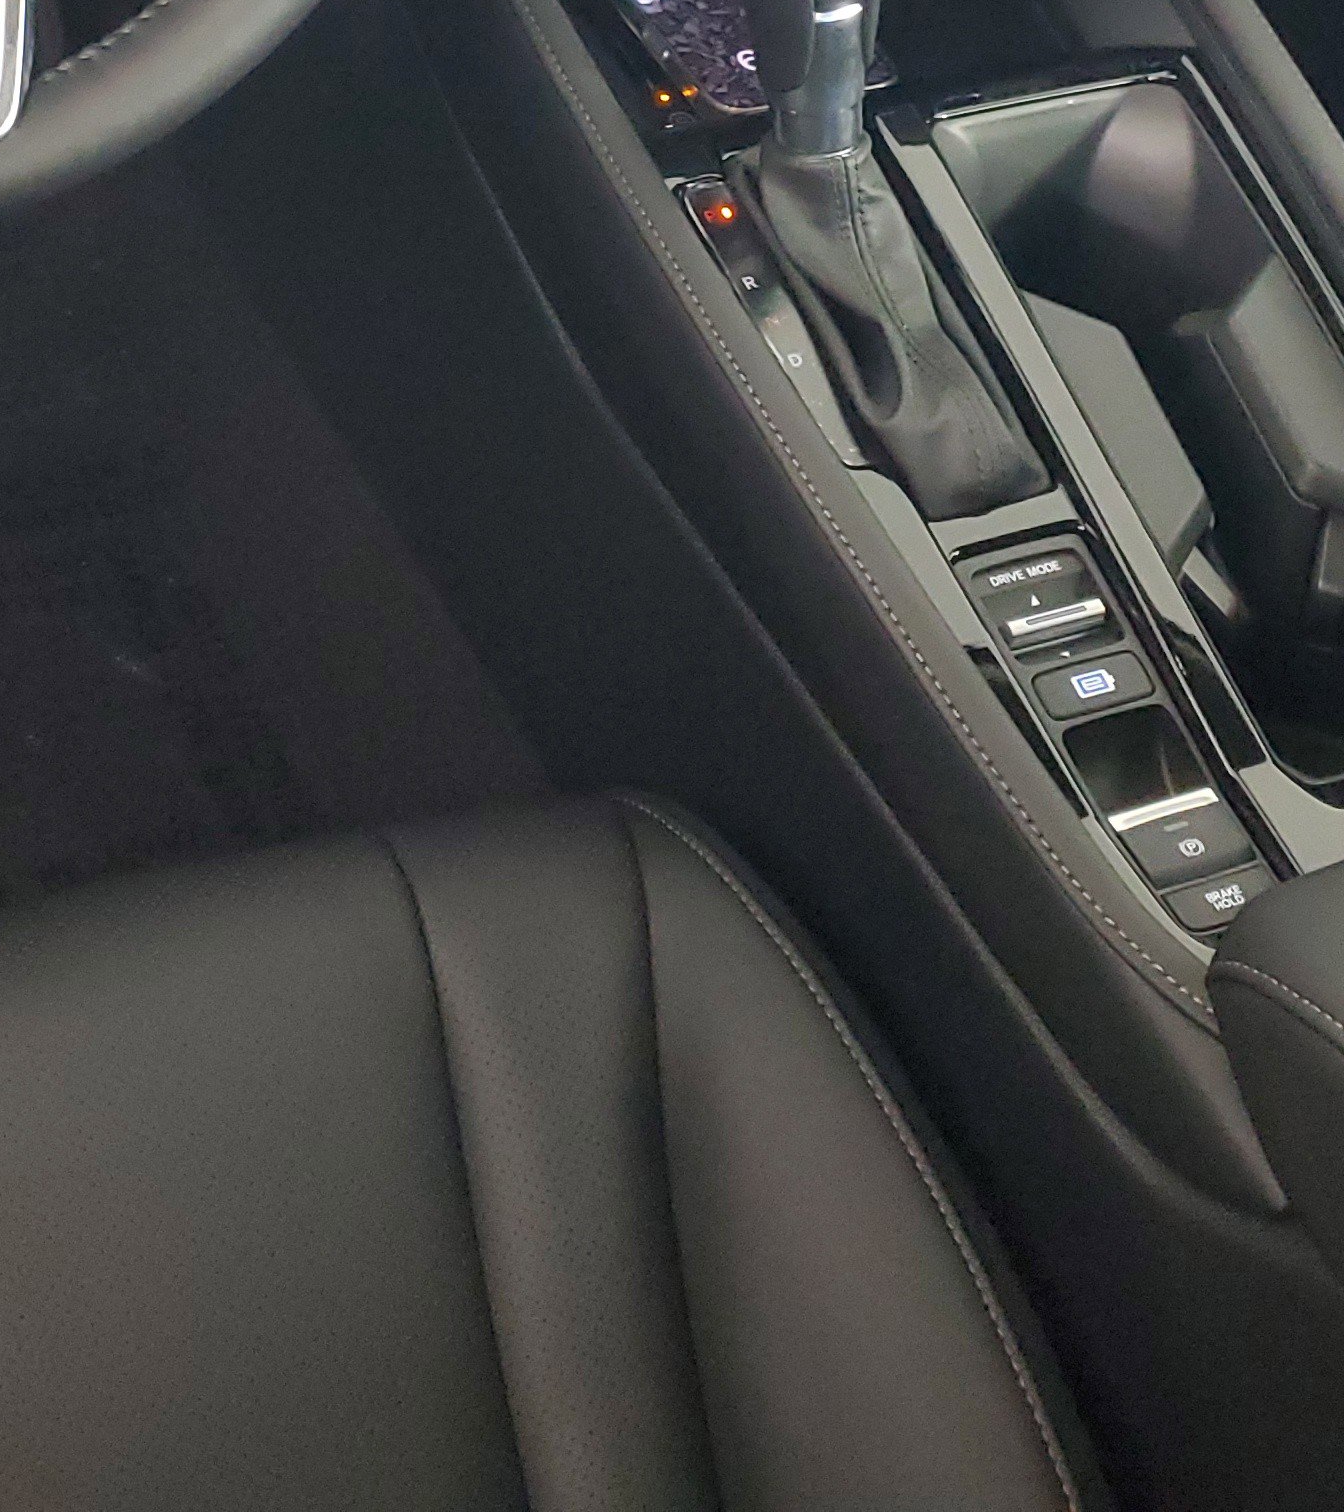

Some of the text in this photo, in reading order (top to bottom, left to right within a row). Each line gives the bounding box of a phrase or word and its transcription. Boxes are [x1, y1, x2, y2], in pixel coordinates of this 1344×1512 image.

[741, 275, 759, 291] R
[787, 353, 803, 368] D
[989, 559, 1062, 589] DRIVE MODE
[1204, 884, 1244, 904] BRAKE
[1212, 894, 1245, 912] HOLD
